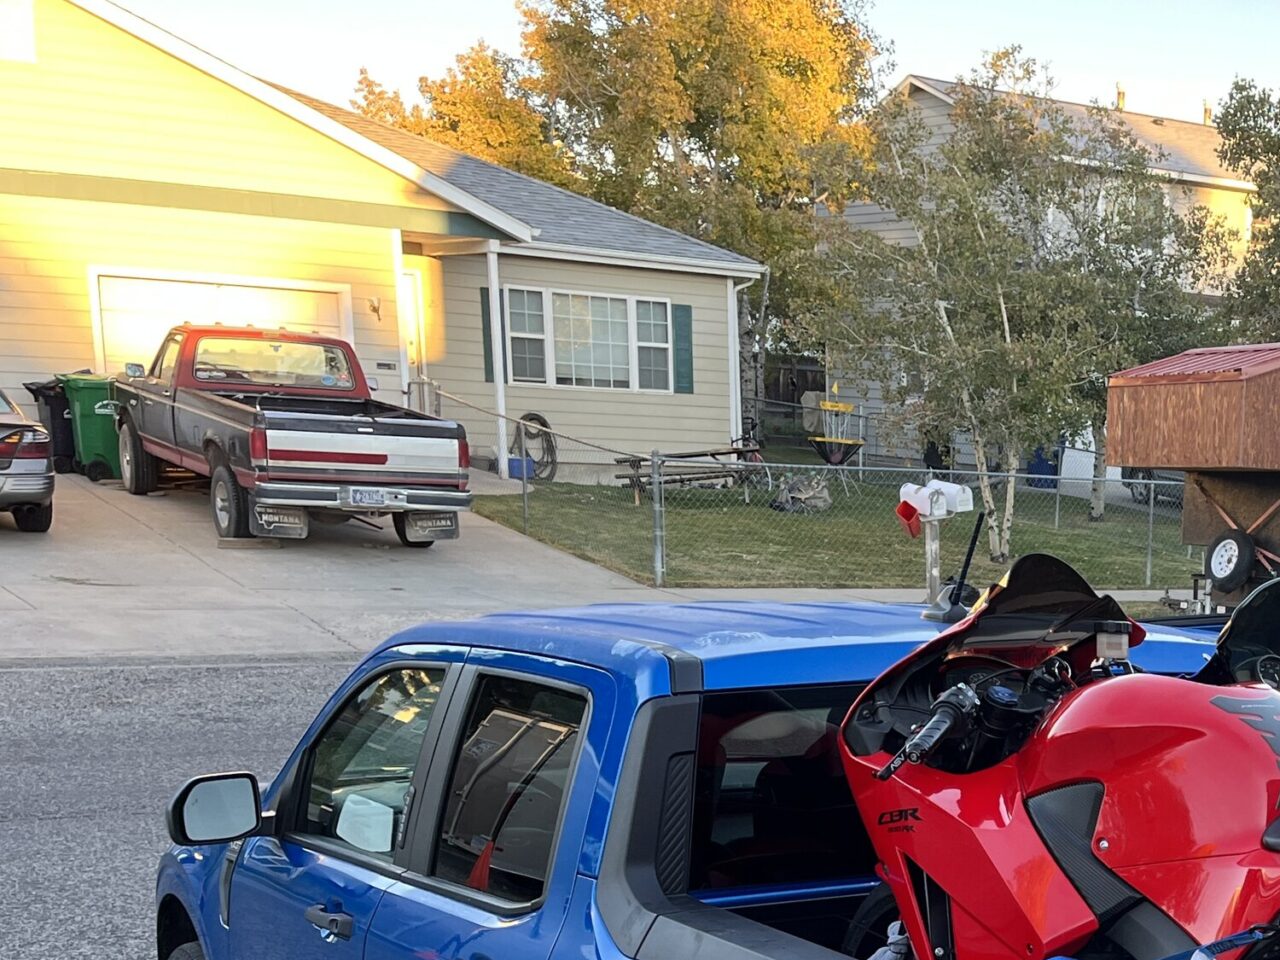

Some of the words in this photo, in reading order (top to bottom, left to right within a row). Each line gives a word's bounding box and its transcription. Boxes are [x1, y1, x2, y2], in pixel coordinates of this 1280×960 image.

[262, 514, 300, 523] MONTANA
[417, 519, 452, 527] MONTANA
[890, 753, 905, 771] ASV
[878, 808, 923, 825] CBR
